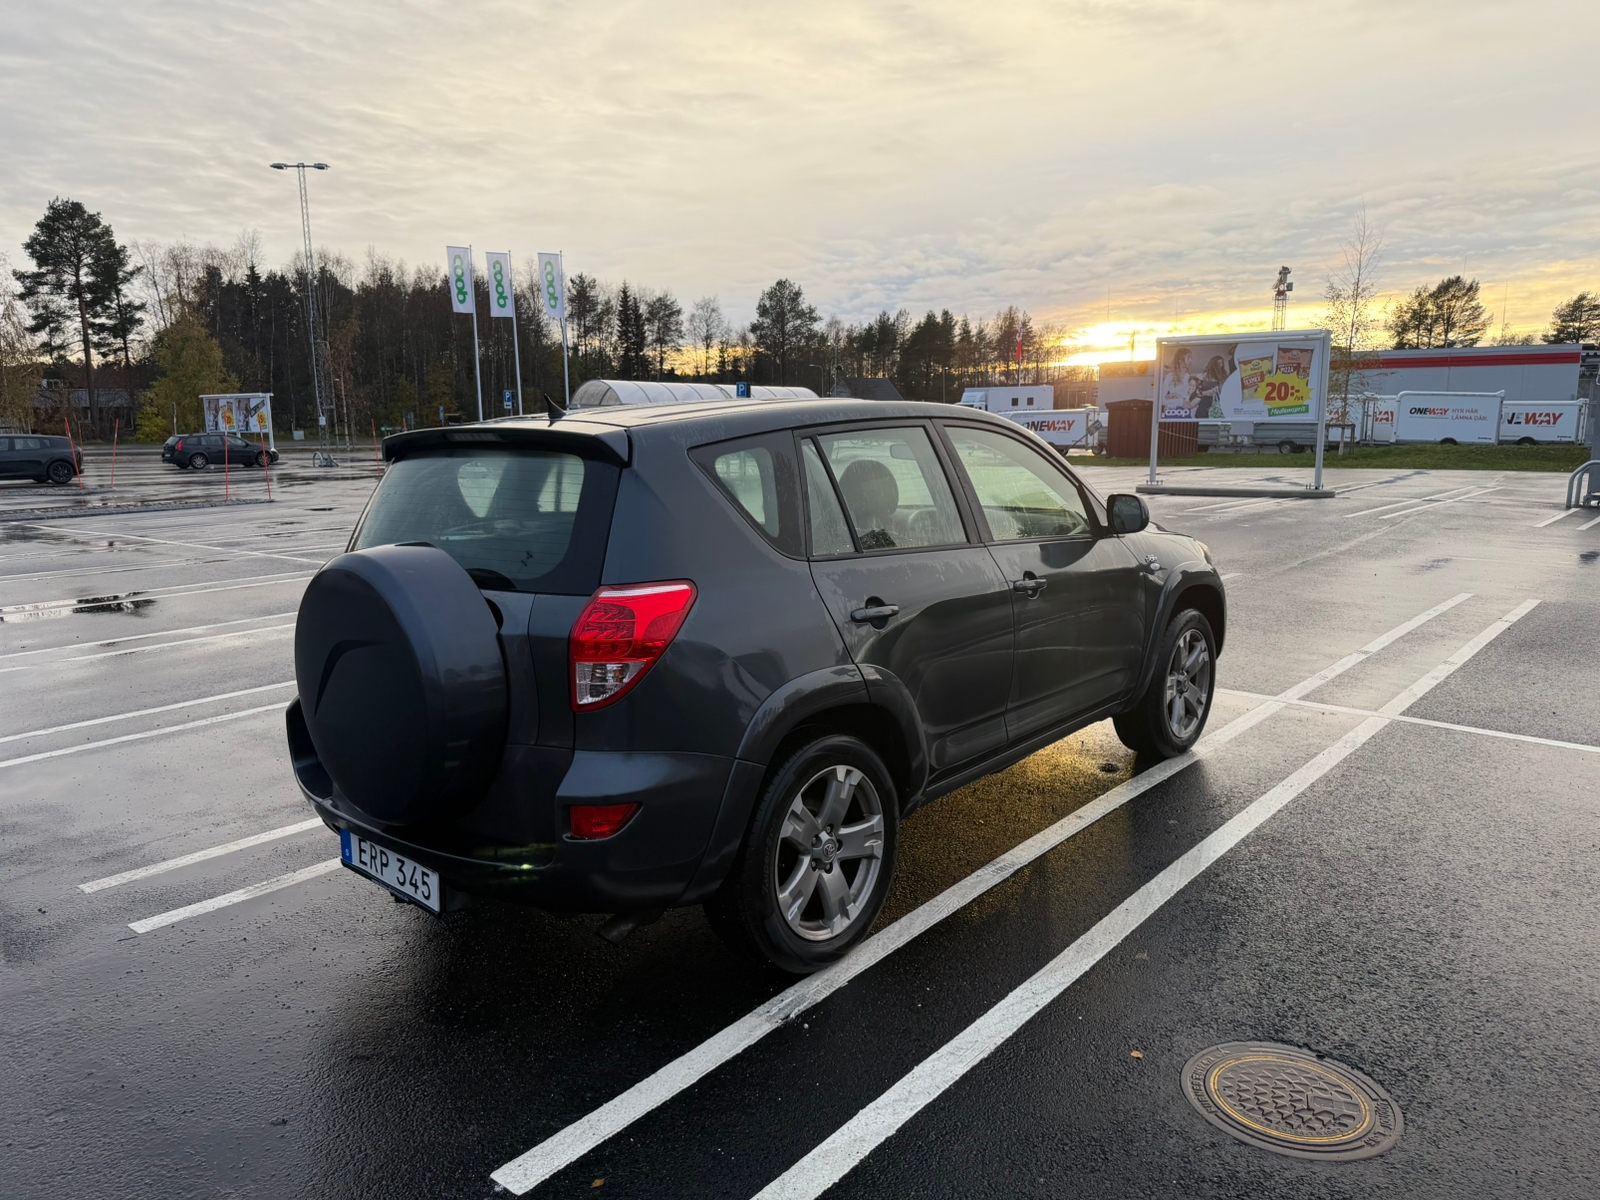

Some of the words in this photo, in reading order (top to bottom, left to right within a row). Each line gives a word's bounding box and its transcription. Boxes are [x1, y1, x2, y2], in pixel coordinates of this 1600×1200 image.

[493, 260, 508, 308] coop
[544, 260, 558, 309] coop
[1165, 408, 1190, 417] coop
[1270, 405, 1306, 416] Medlemspris
[1409, 407, 1450, 416] ONEWAY
[358, 837, 389, 876] ERP
[396, 857, 431, 901] 345
